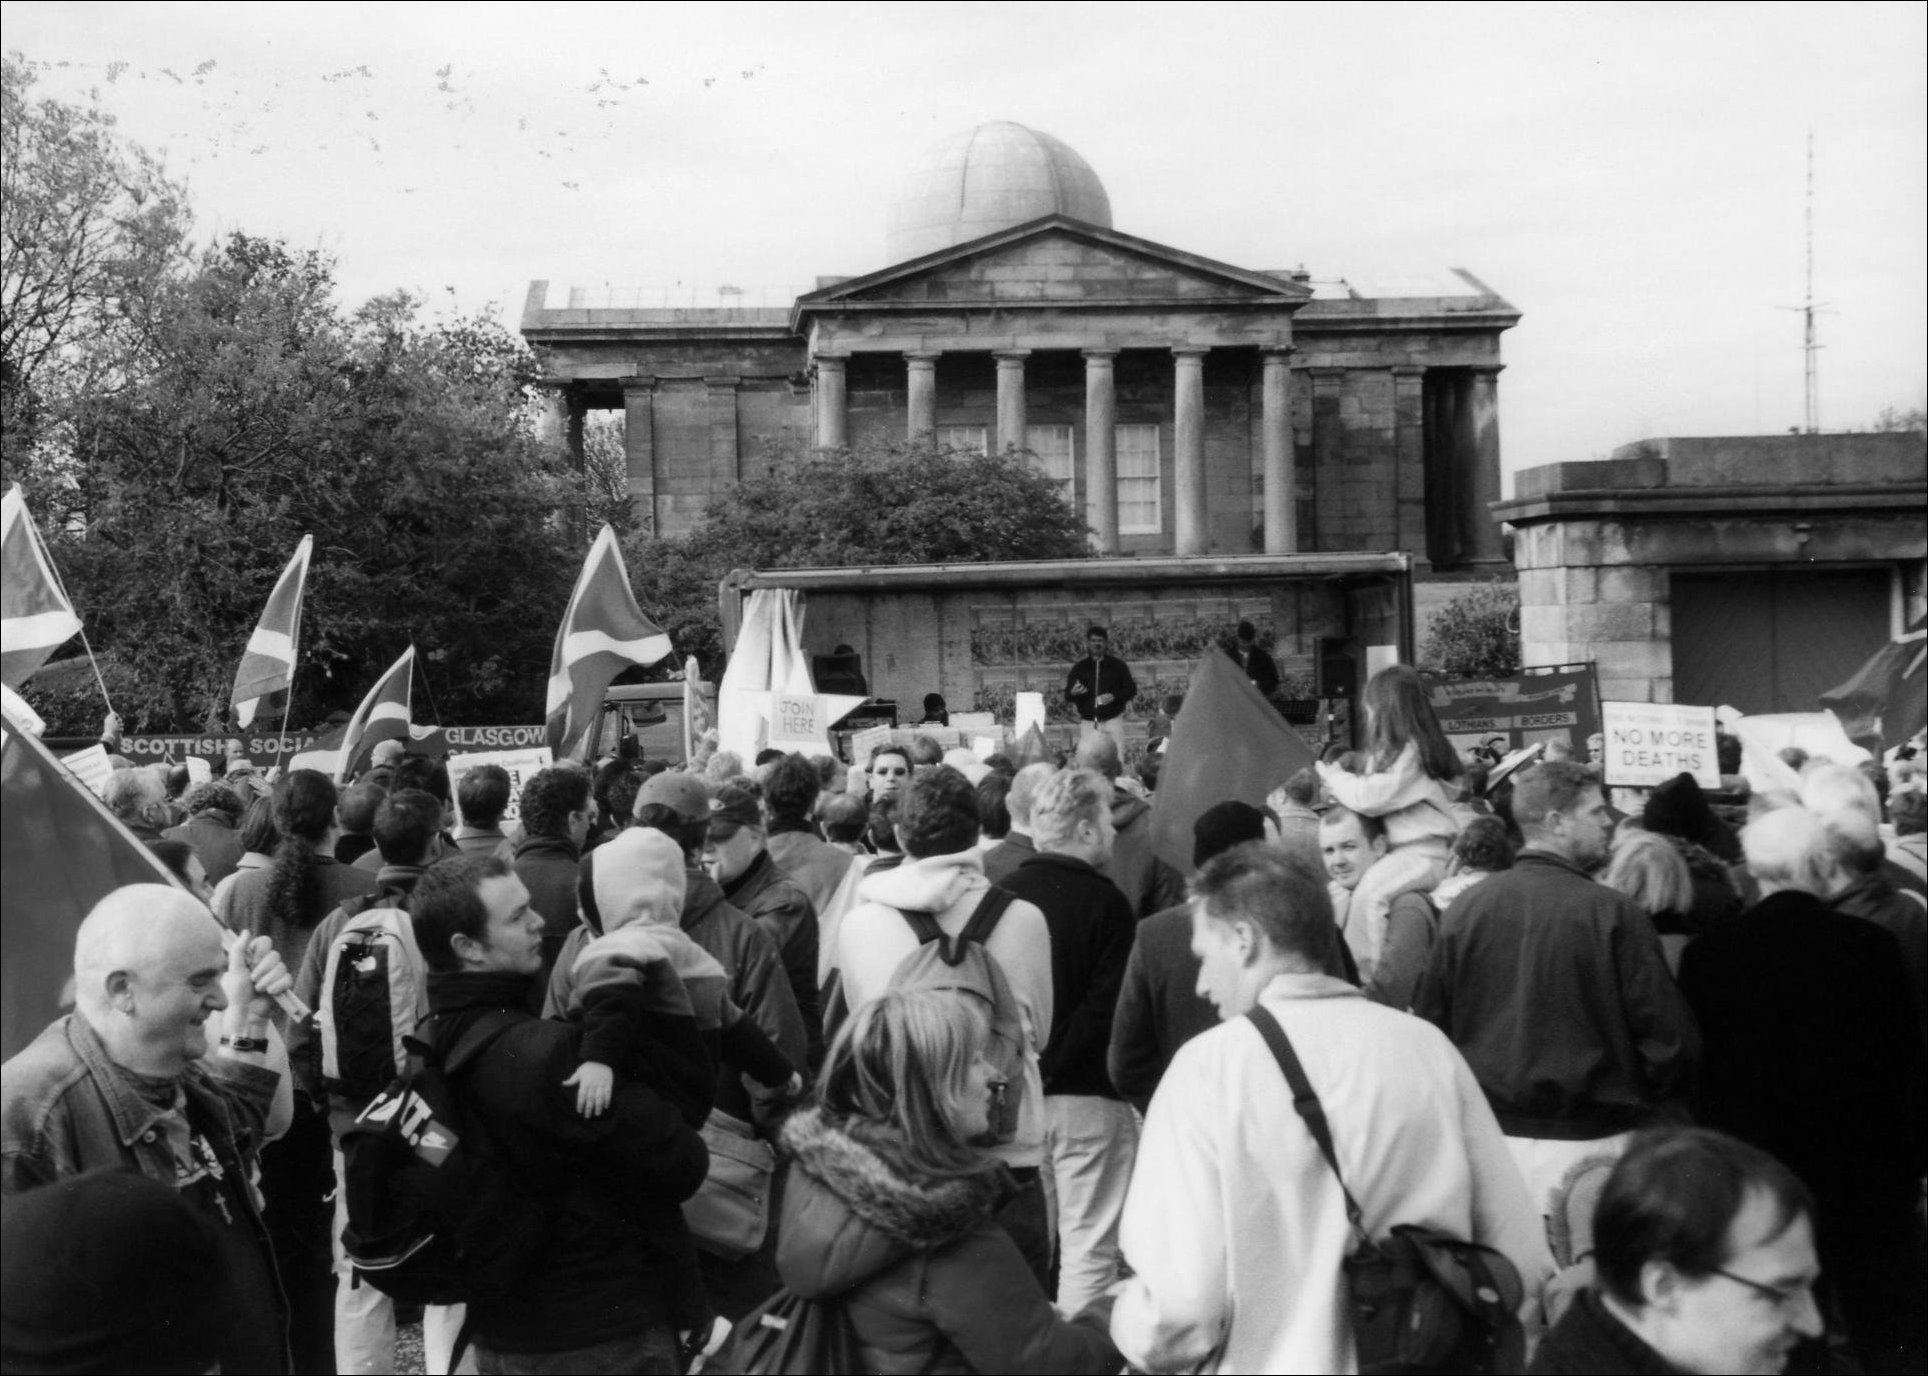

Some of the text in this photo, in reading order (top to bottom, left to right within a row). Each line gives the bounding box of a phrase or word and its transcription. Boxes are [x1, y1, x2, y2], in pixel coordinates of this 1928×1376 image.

[779, 700, 815, 717] JOIN
[783, 716, 815, 734] HERE
[1520, 713, 1570, 727] BORDERS
[445, 728, 546, 746] GLASGOW
[1613, 729, 1708, 750] NO MORE
[1622, 750, 1702, 771] DEATHS
